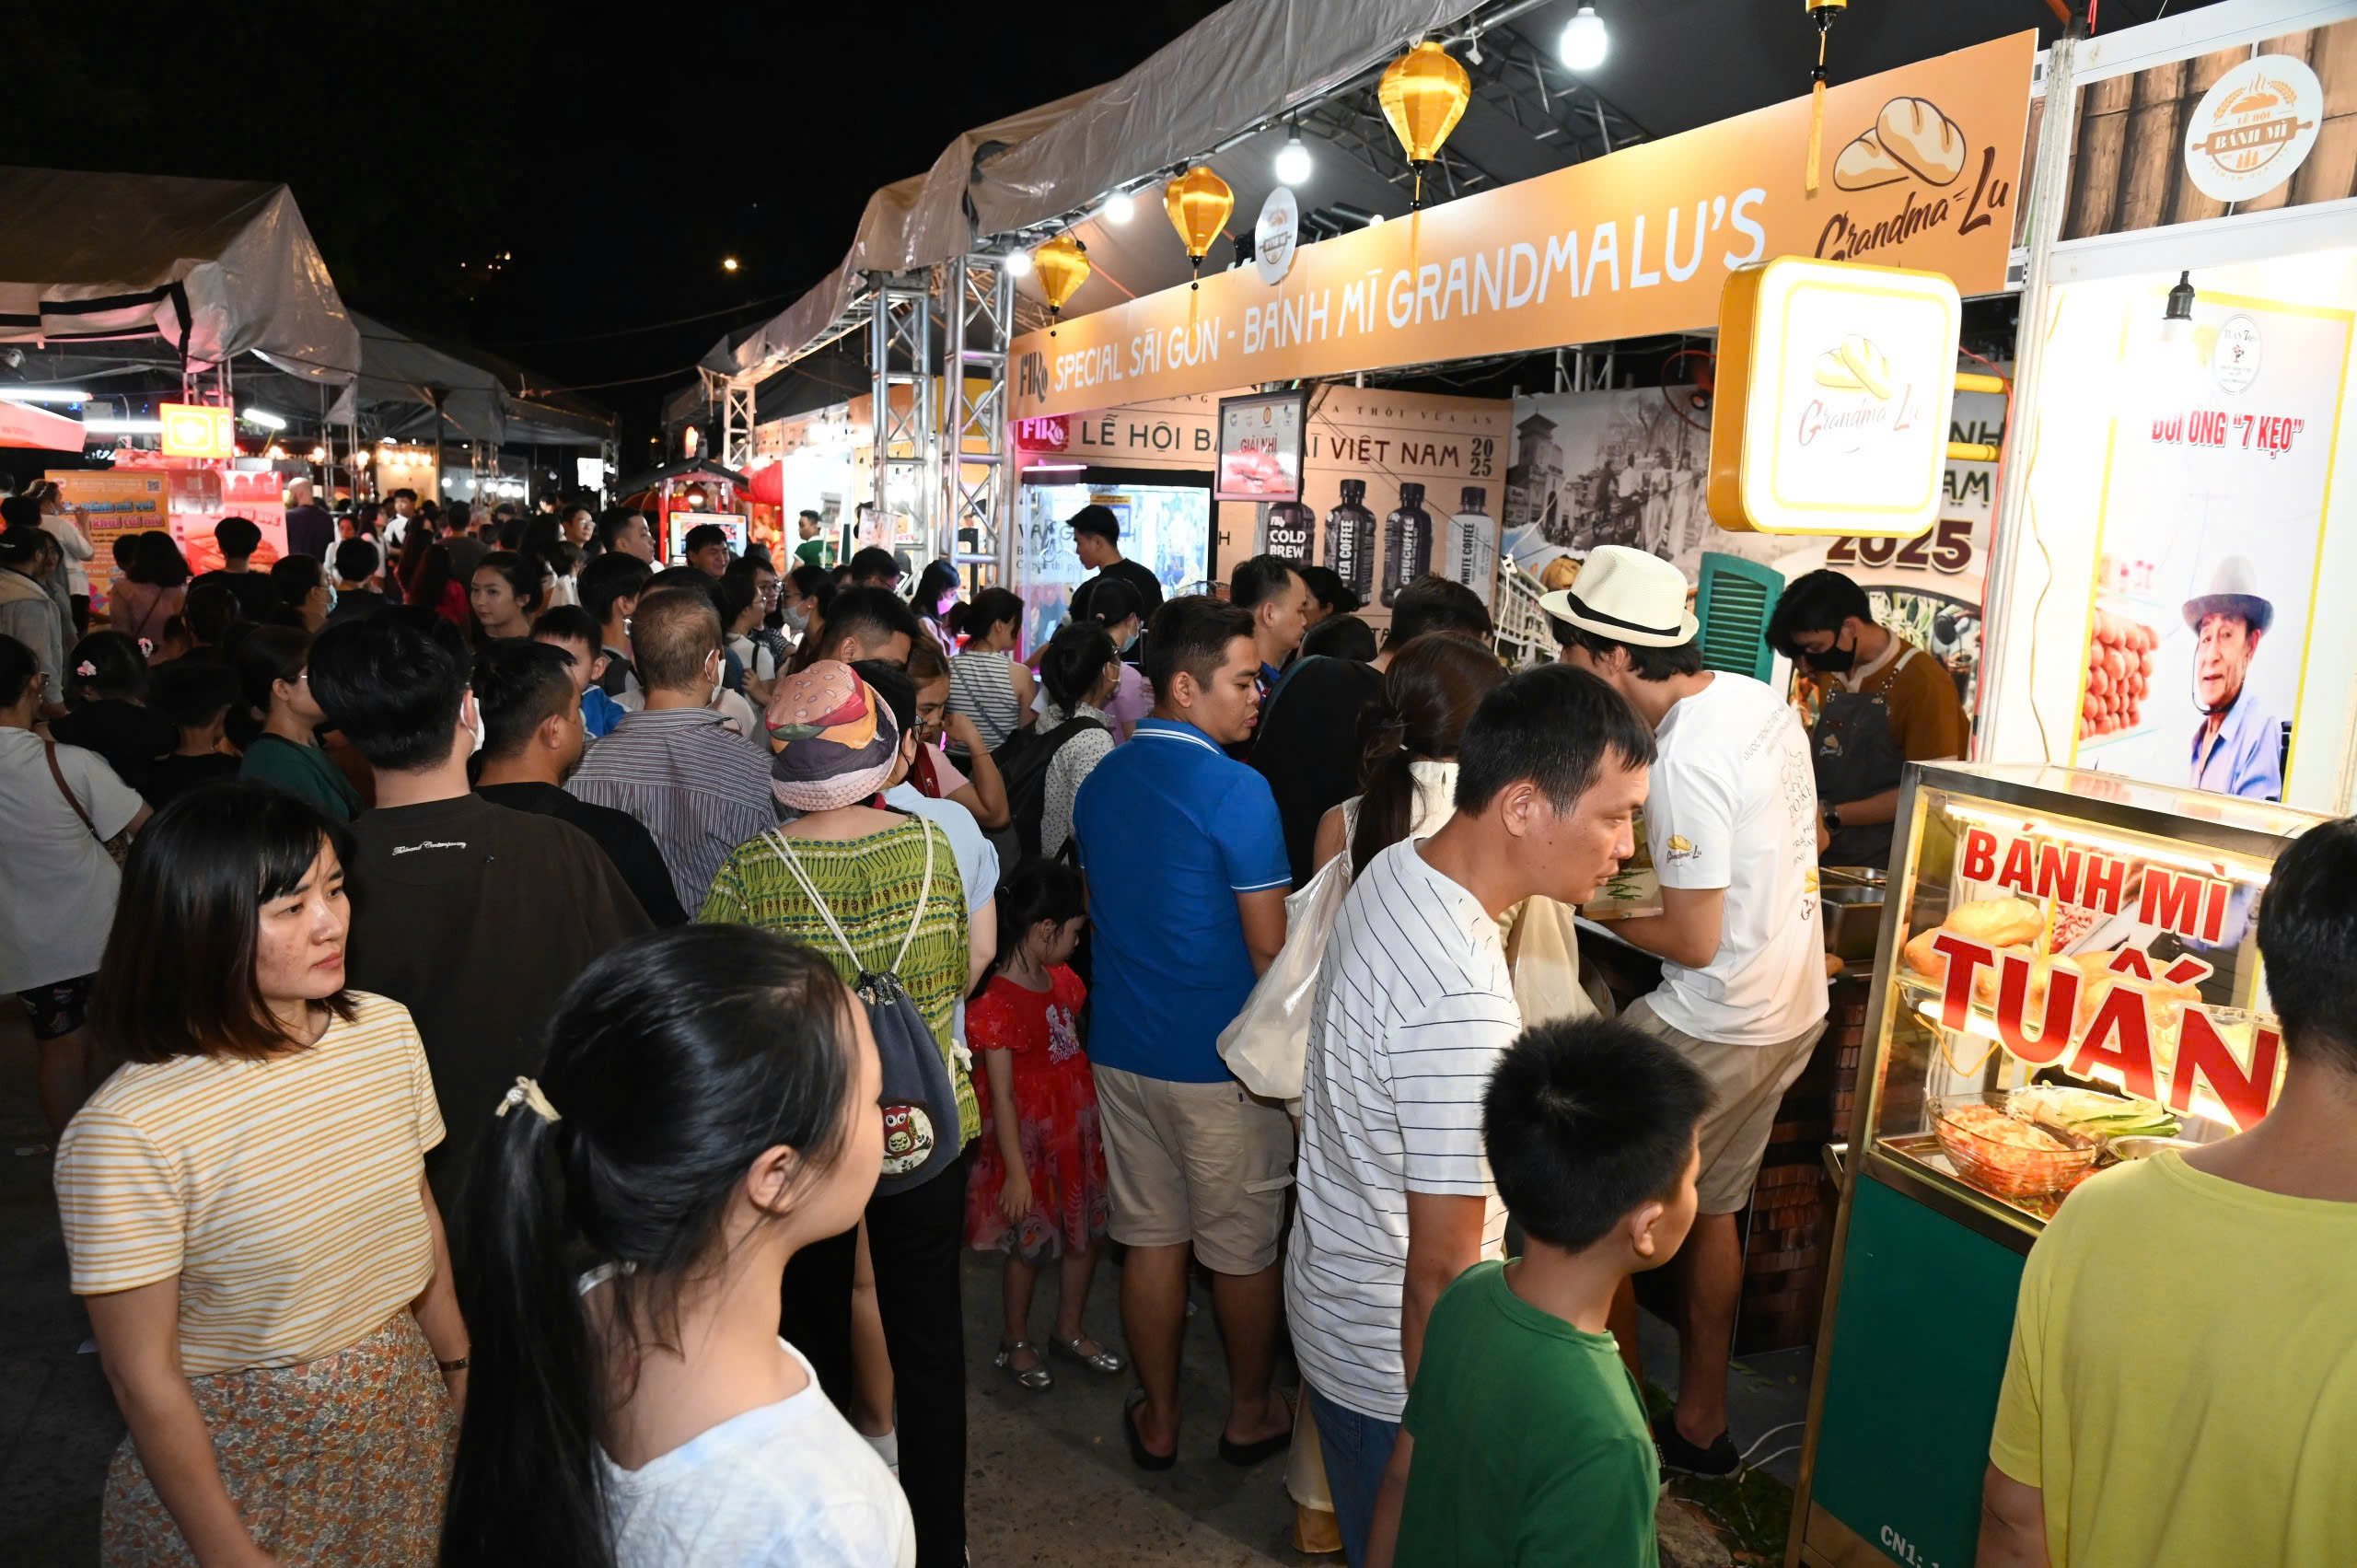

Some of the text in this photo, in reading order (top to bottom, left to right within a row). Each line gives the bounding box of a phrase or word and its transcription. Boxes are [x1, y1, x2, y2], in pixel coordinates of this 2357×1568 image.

[1814, 145, 2009, 262] Grandma Lu
[1054, 342, 1123, 393] SPECIAL
[1082, 414, 1119, 447] LỄ
[1129, 421, 1181, 453] HỘI
[1331, 435, 1391, 464] VIỆT
[1400, 442, 1459, 469] NAM
[1270, 529, 1306, 543] COLD
[1270, 544, 1305, 558] BREW
[1339, 519, 1353, 580] TEA COFFEE
[1961, 823, 2234, 944] BÁNH MÌ
[1933, 934, 2282, 1134] TUẤN
